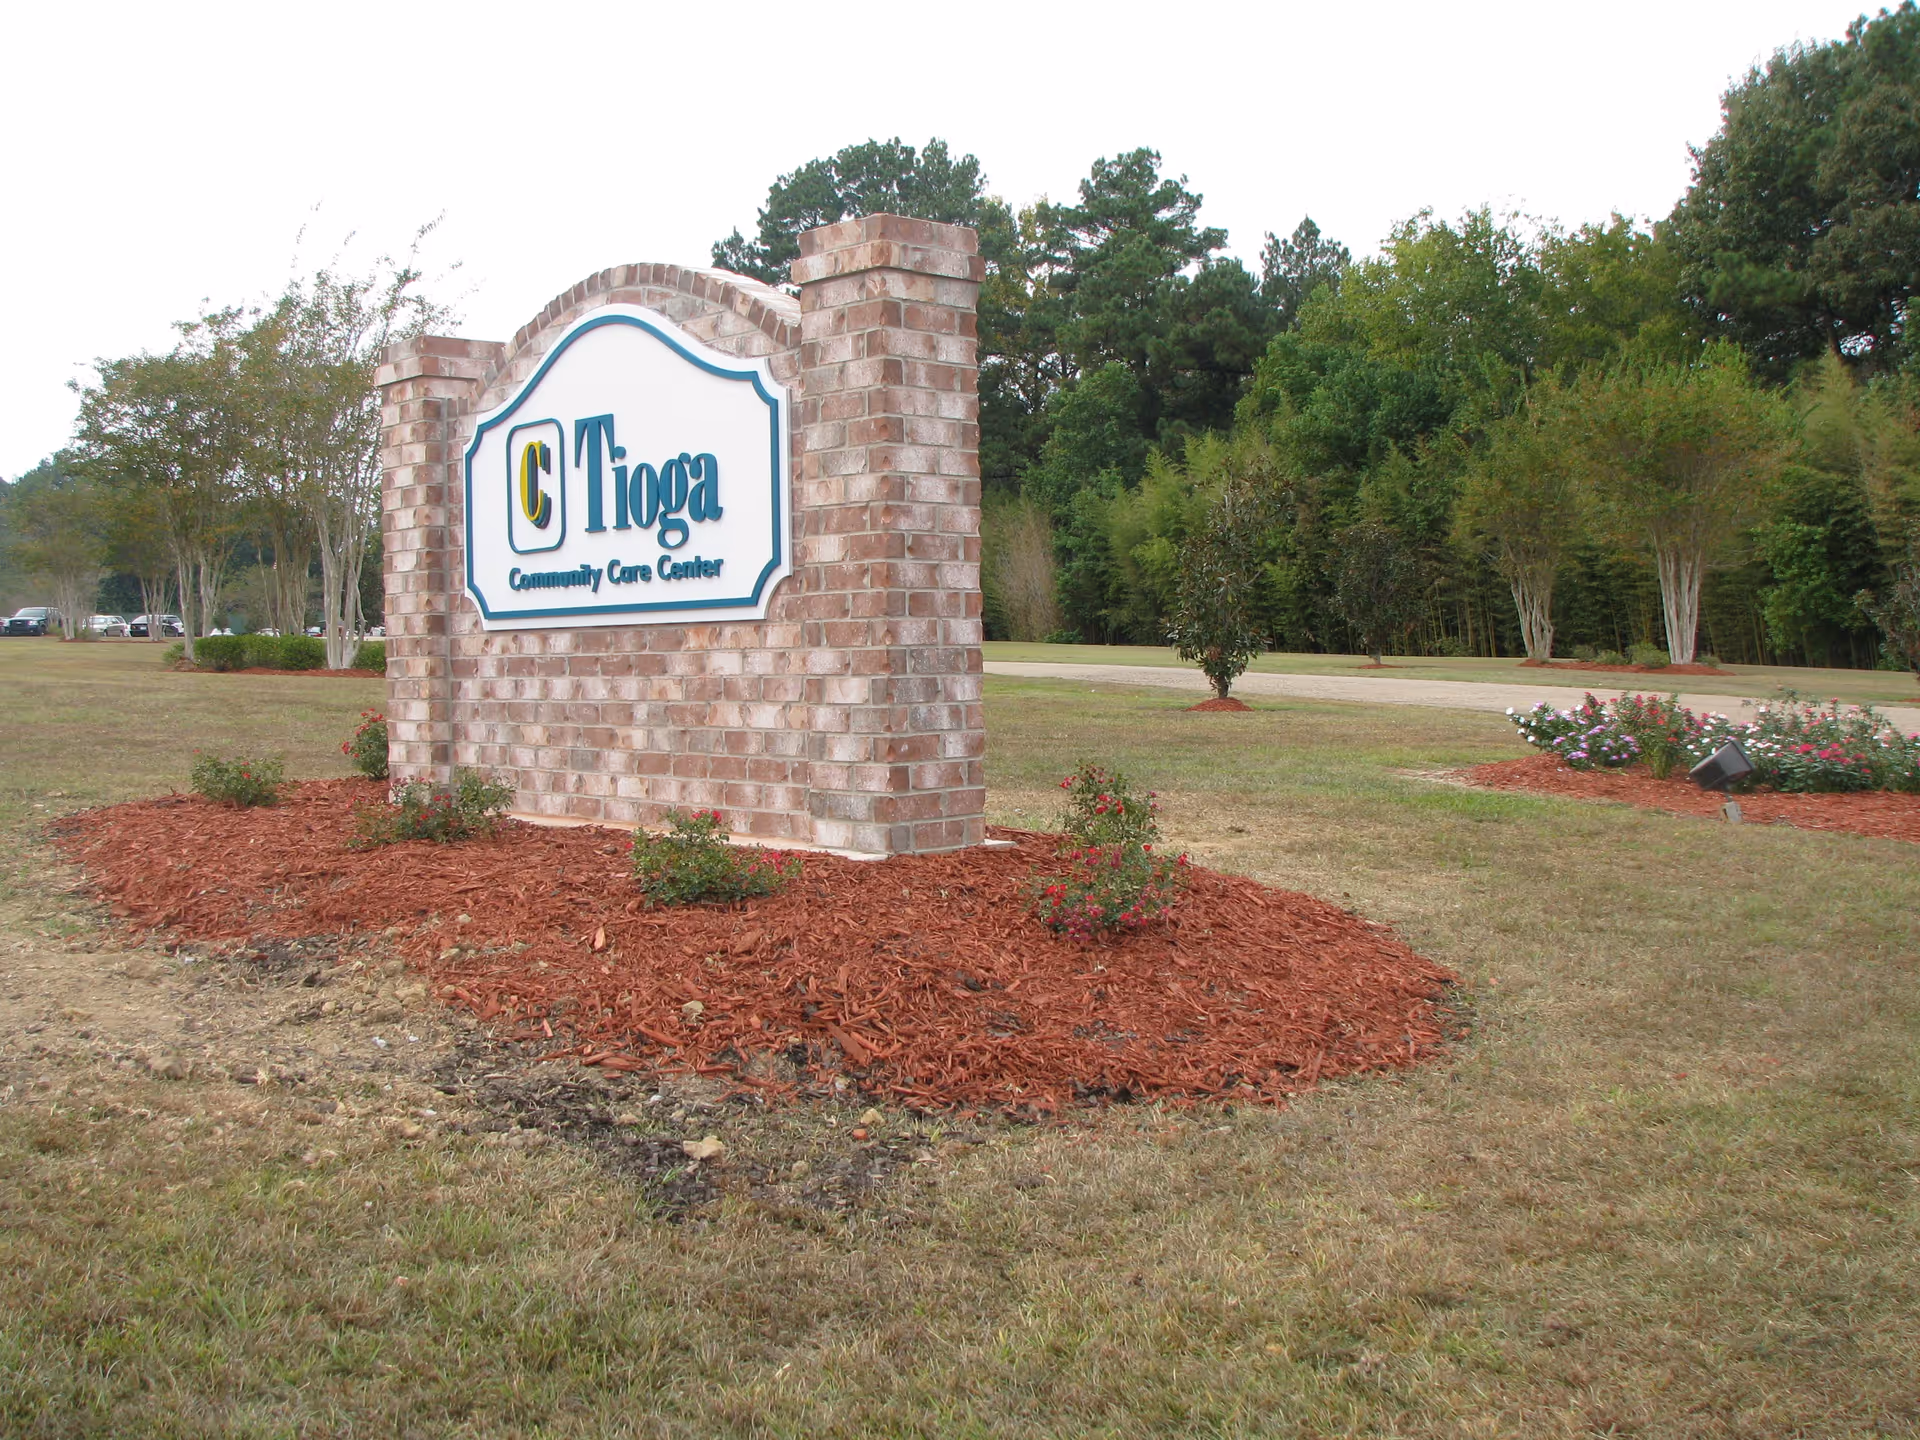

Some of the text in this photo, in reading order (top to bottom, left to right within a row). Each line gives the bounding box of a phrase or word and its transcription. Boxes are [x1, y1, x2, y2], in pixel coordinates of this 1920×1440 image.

[574, 413, 724, 549] Tioga
[508, 554, 724, 593] Community Care Center
